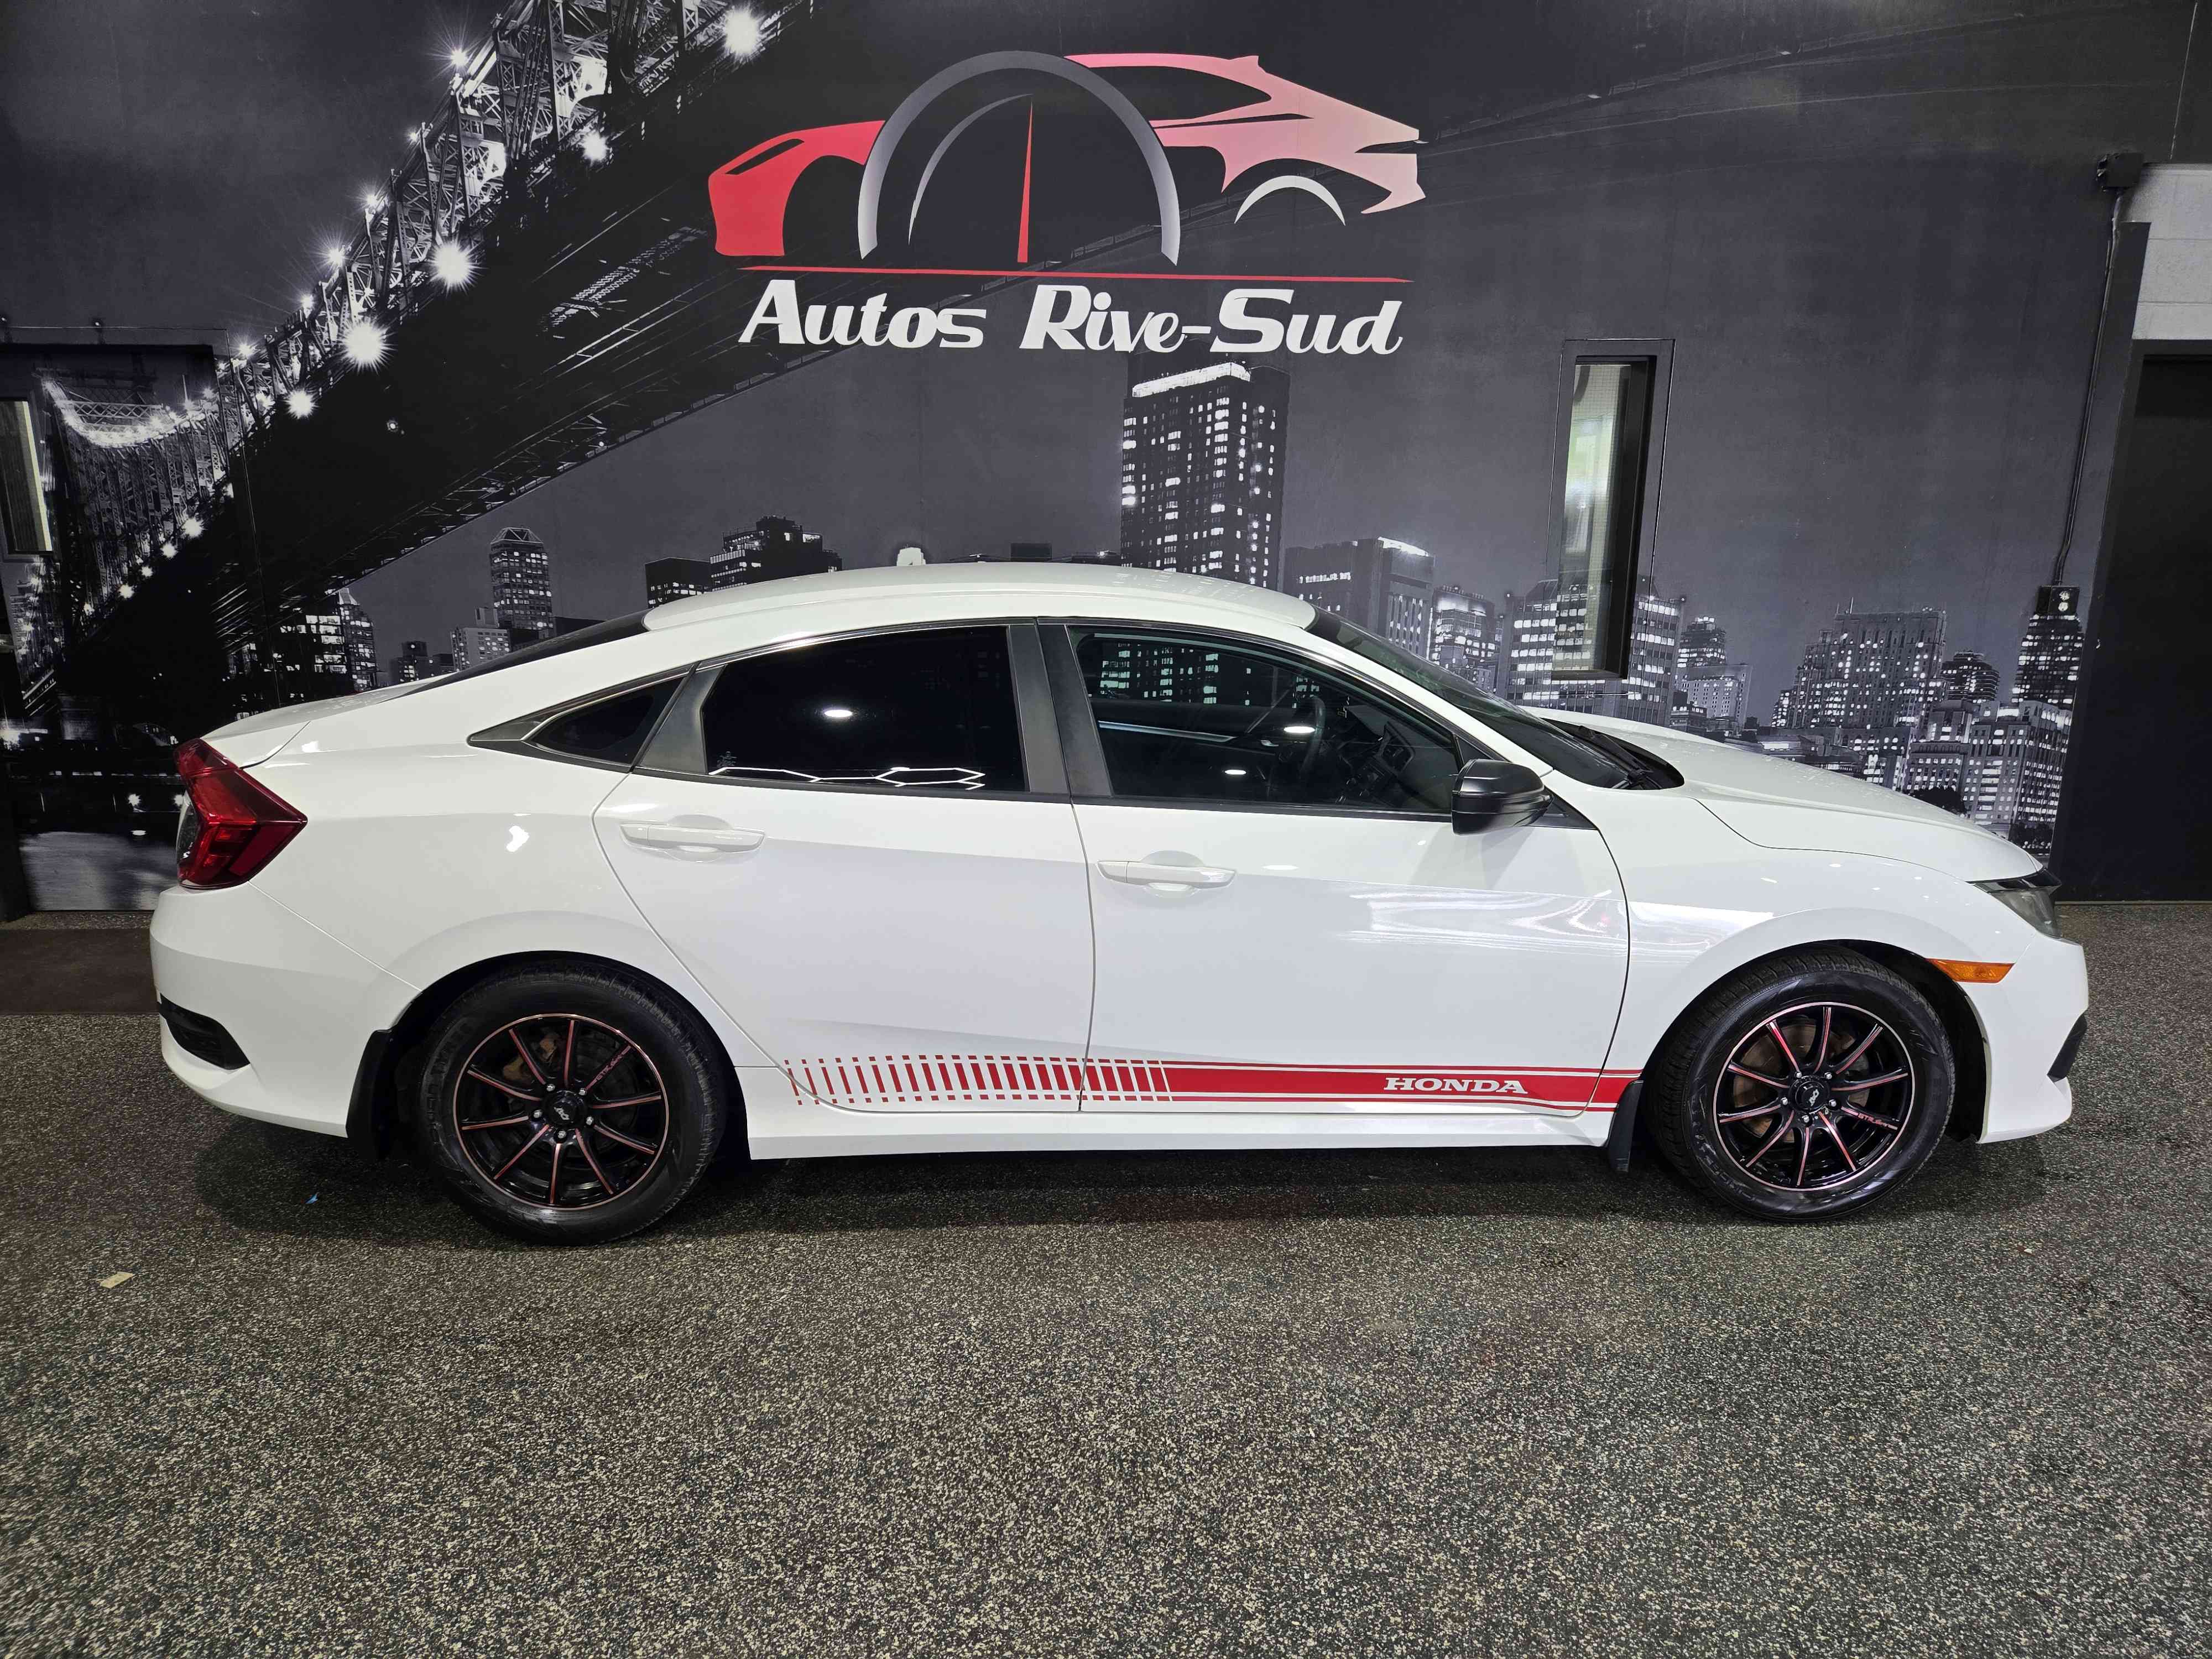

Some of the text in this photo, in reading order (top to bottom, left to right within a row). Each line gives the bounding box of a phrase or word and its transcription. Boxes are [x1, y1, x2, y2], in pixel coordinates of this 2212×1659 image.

[738, 279, 1403, 354] Autos Rive-Sud
[1383, 1077, 1528, 1094] HONDA
